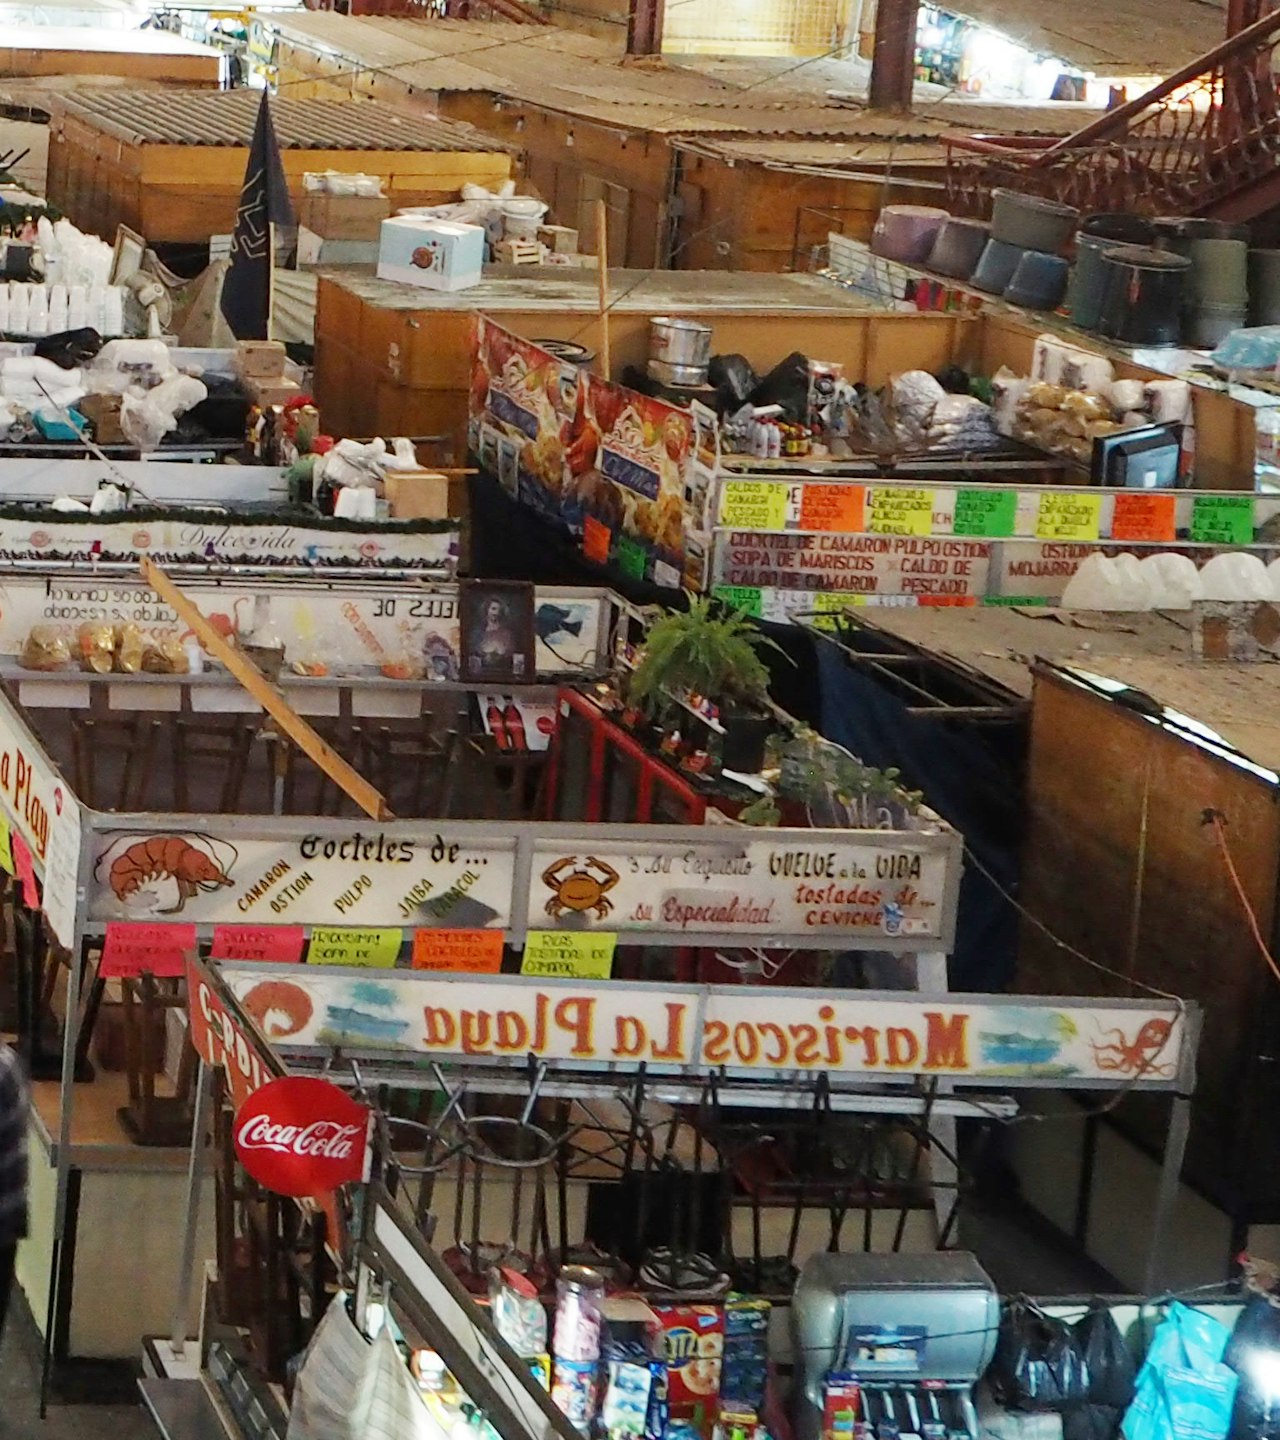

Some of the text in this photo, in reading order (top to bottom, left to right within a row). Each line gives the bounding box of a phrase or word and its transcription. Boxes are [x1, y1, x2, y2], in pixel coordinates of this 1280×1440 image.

[180, 521, 245, 548] Dulce
[797, 534, 816, 550] DE
[820, 535, 890, 555] CAMARON
[894, 538, 941, 556] PULPO
[731, 551, 972, 575] SOPA DE MARISCOS CALDO DE
[730, 569, 969, 595] CALDO DE CAMARON PESCADO
[14, 747, 51, 860] Play
[300, 831, 416, 865] Cocteles
[768, 852, 836, 879] VUELVE
[851, 863, 866, 879] la
[876, 854, 922, 881] VIDA
[238, 859, 292, 913] CAMARON
[270, 871, 315, 915] OSTION
[334, 873, 373, 915] PULPO
[401, 878, 435, 919] JAIBA
[796, 883, 883, 906] tostadas
[238, 1113, 363, 1160] Coca-Cola
